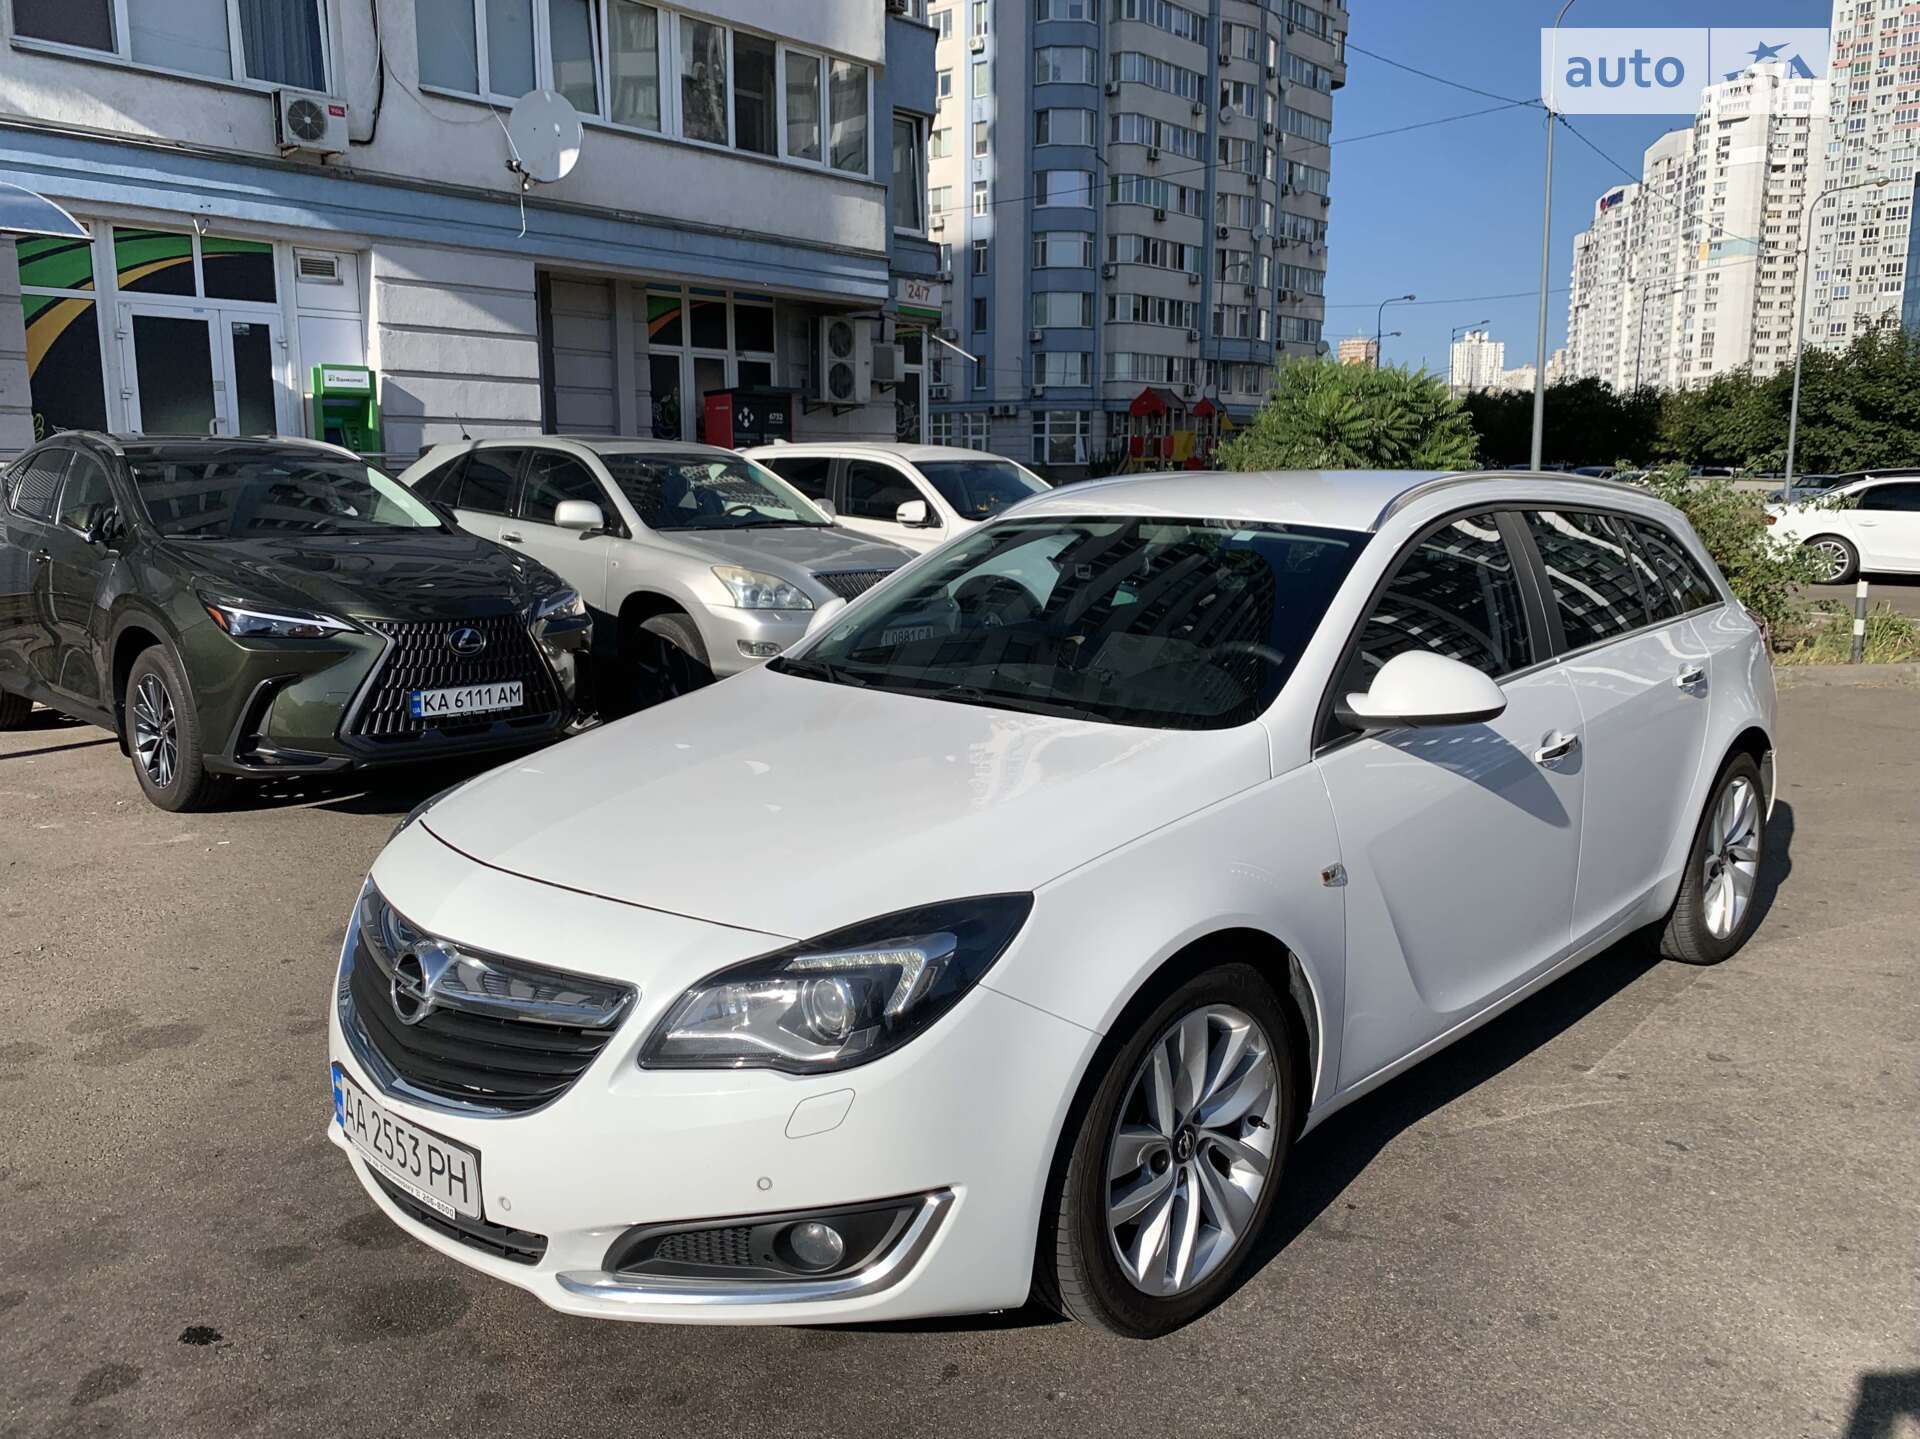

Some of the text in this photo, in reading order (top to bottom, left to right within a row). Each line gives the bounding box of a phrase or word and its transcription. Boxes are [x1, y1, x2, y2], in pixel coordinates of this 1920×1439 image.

[907, 284, 930, 302] 24/7
[412, 706, 421, 714] UA
[423, 693, 449, 713] KA
[455, 687, 492, 709] 6111
[497, 685, 521, 705] AM
[345, 1088, 368, 1142] AA
[371, 1110, 422, 1178] 2553
[428, 1144, 468, 1204] PH
